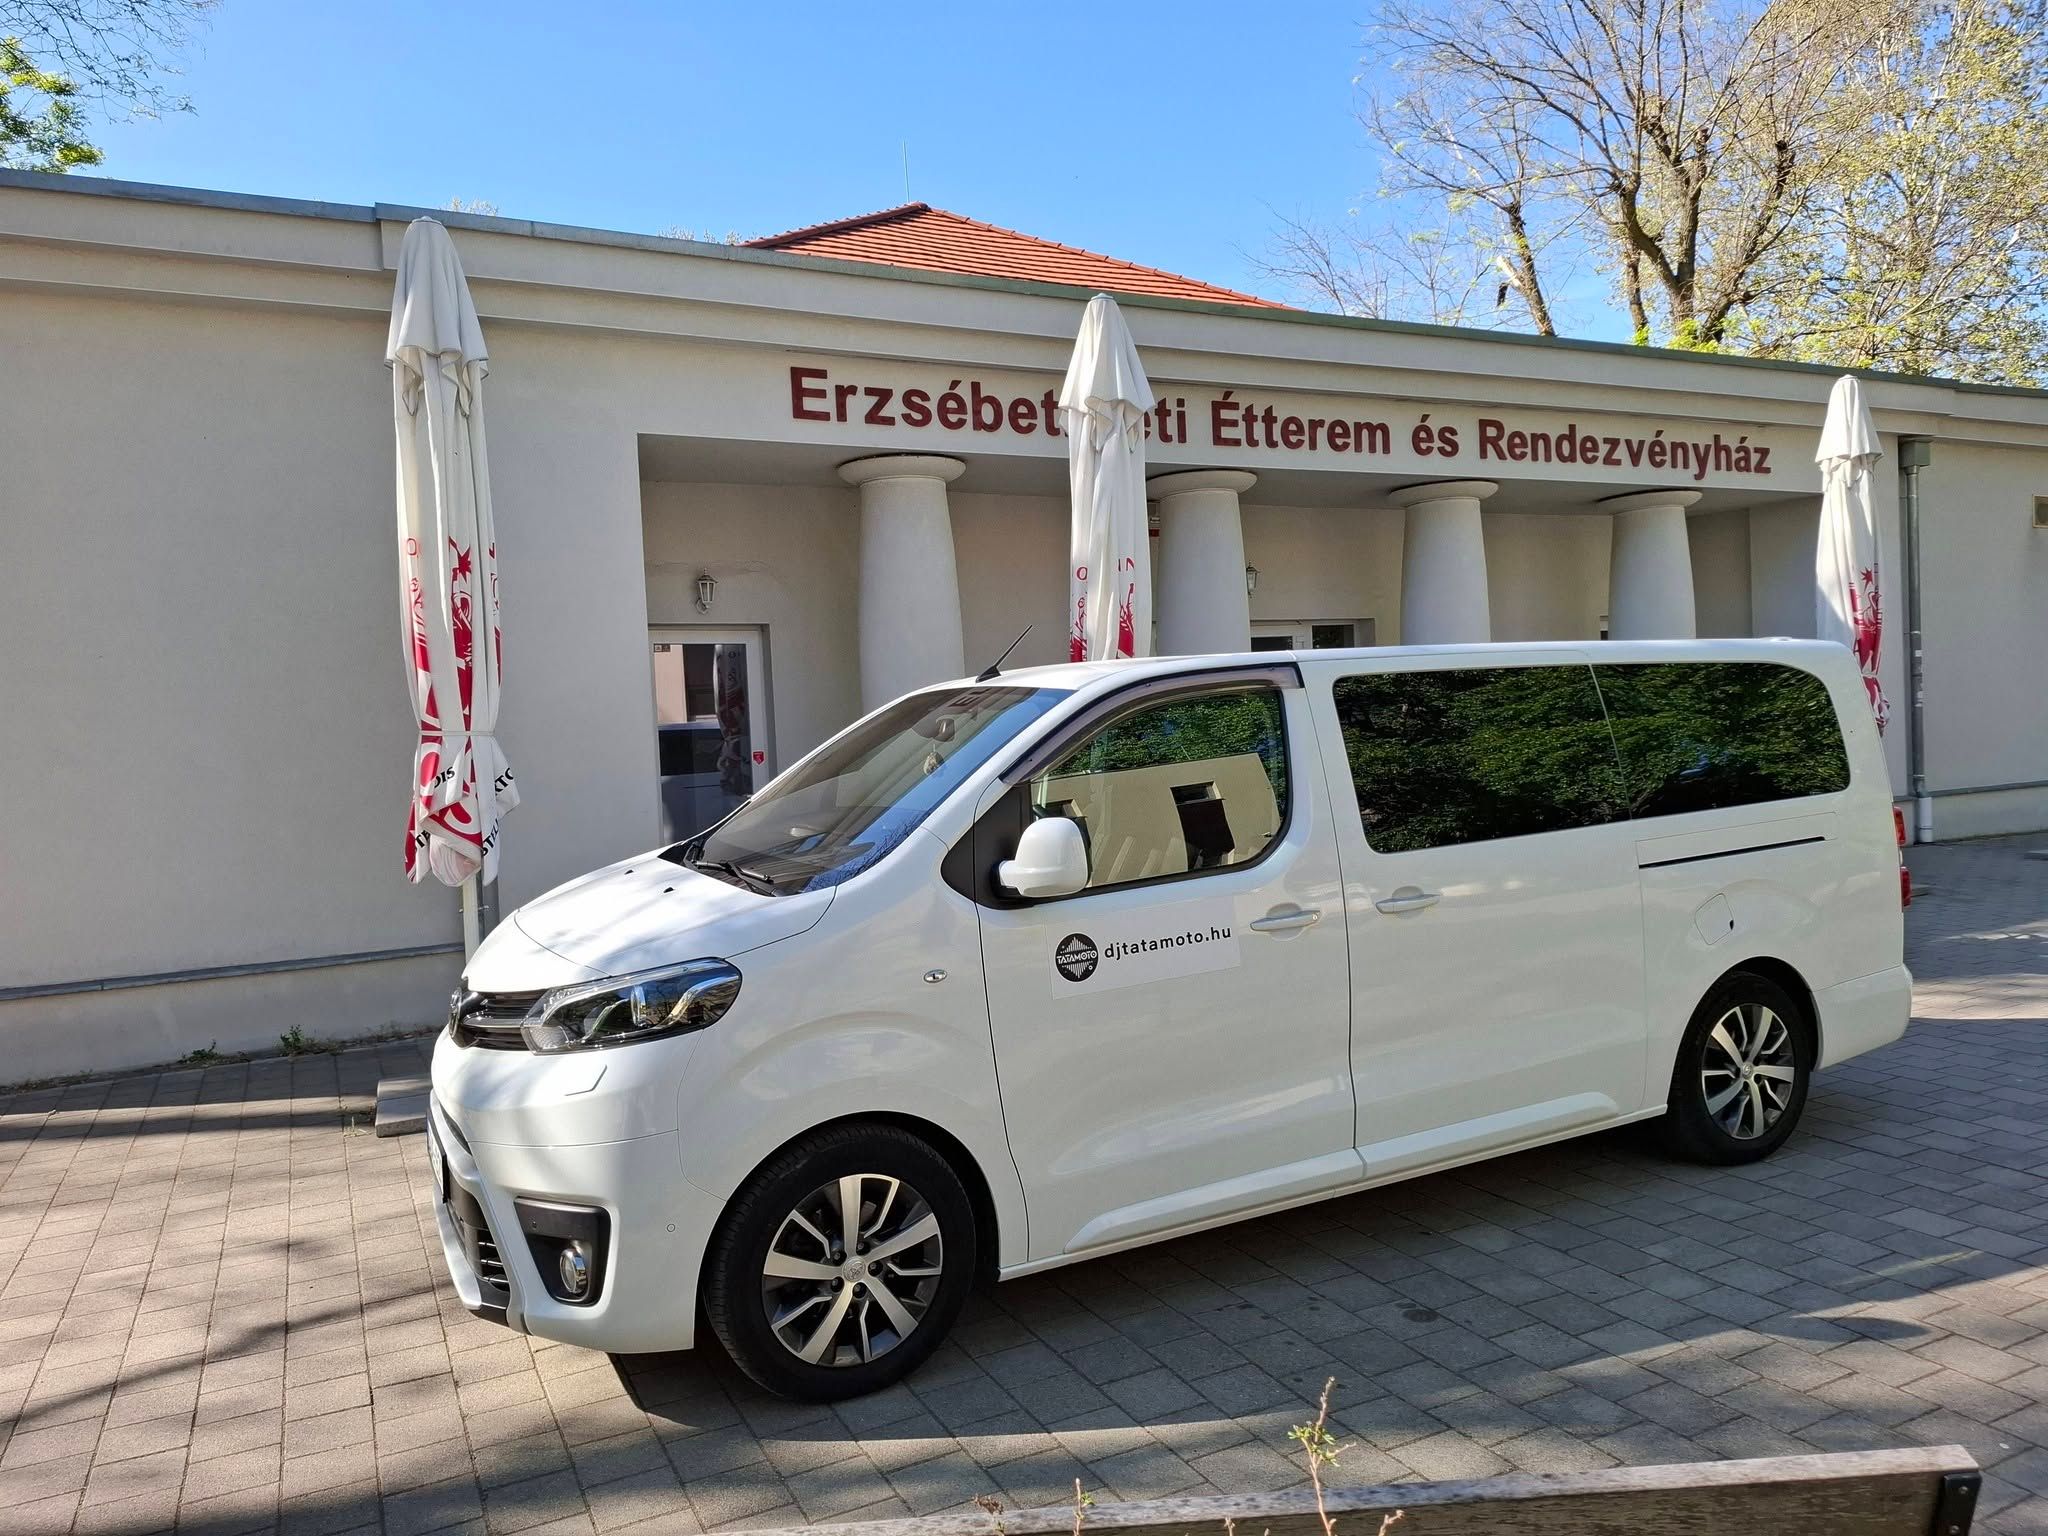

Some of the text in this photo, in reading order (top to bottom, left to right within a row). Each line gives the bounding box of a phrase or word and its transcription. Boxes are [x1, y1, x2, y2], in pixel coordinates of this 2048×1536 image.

[1211, 390, 1391, 454] Étterem
[1412, 414, 1460, 458] és
[1478, 418, 1772, 480] Rendezvényház
[1056, 927, 1231, 964] TATAMOTO djtatamoto.hu
